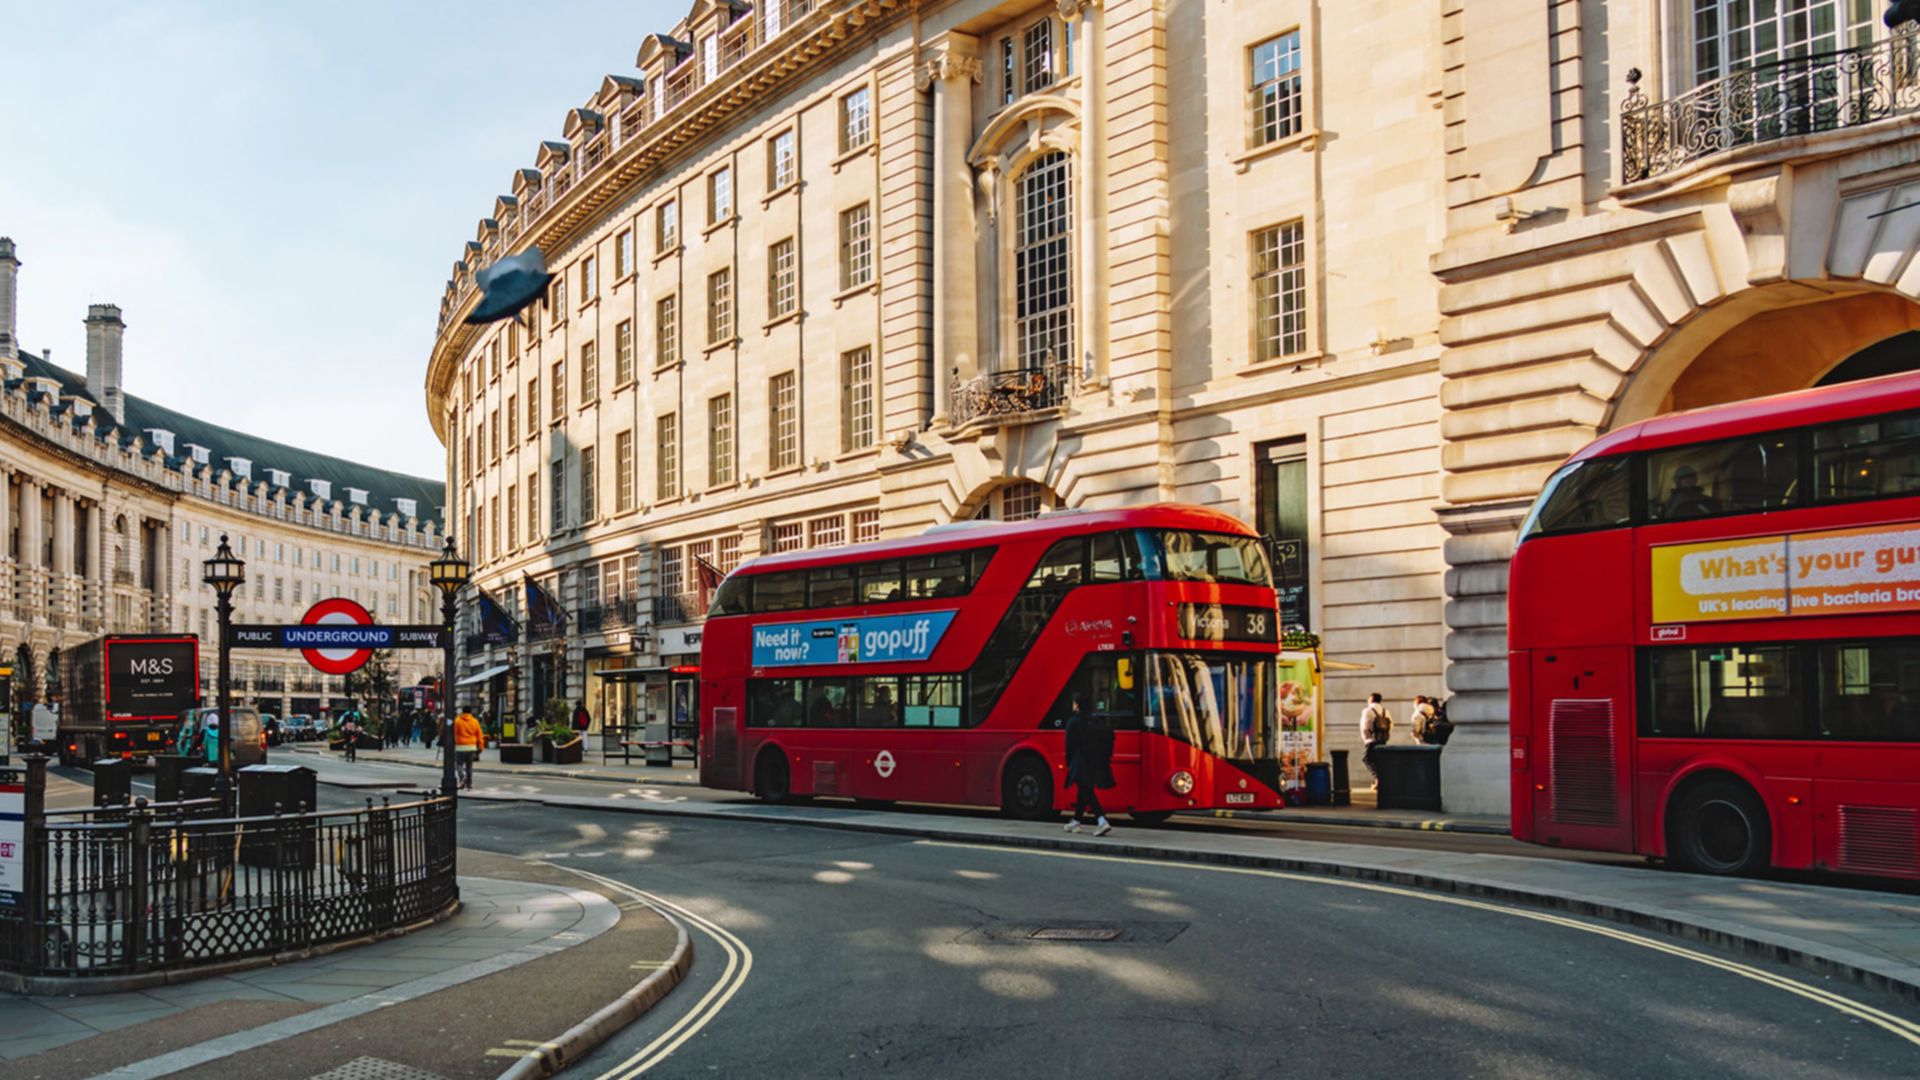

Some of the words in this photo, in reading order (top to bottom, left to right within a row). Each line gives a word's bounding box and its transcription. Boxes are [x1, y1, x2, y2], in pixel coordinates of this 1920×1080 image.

[1699, 552, 1788, 580] What's
[1797, 550, 1865, 579] your
[1699, 599, 1727, 613] UK's
[1732, 595, 1787, 613] leading
[1792, 594, 1818, 608] live
[1823, 589, 1891, 606] bacteria
[1247, 613, 1265, 635] 38
[237, 631, 272, 641] PUBLIC
[286, 631, 389, 642] UNDERGROUND
[399, 632, 439, 641] SUBWAY
[756, 629, 788, 648] Need
[791, 628, 801, 645] it
[865, 619, 930, 657] gopuff
[775, 642, 810, 660] now?
[130, 657, 174, 675] M&S
